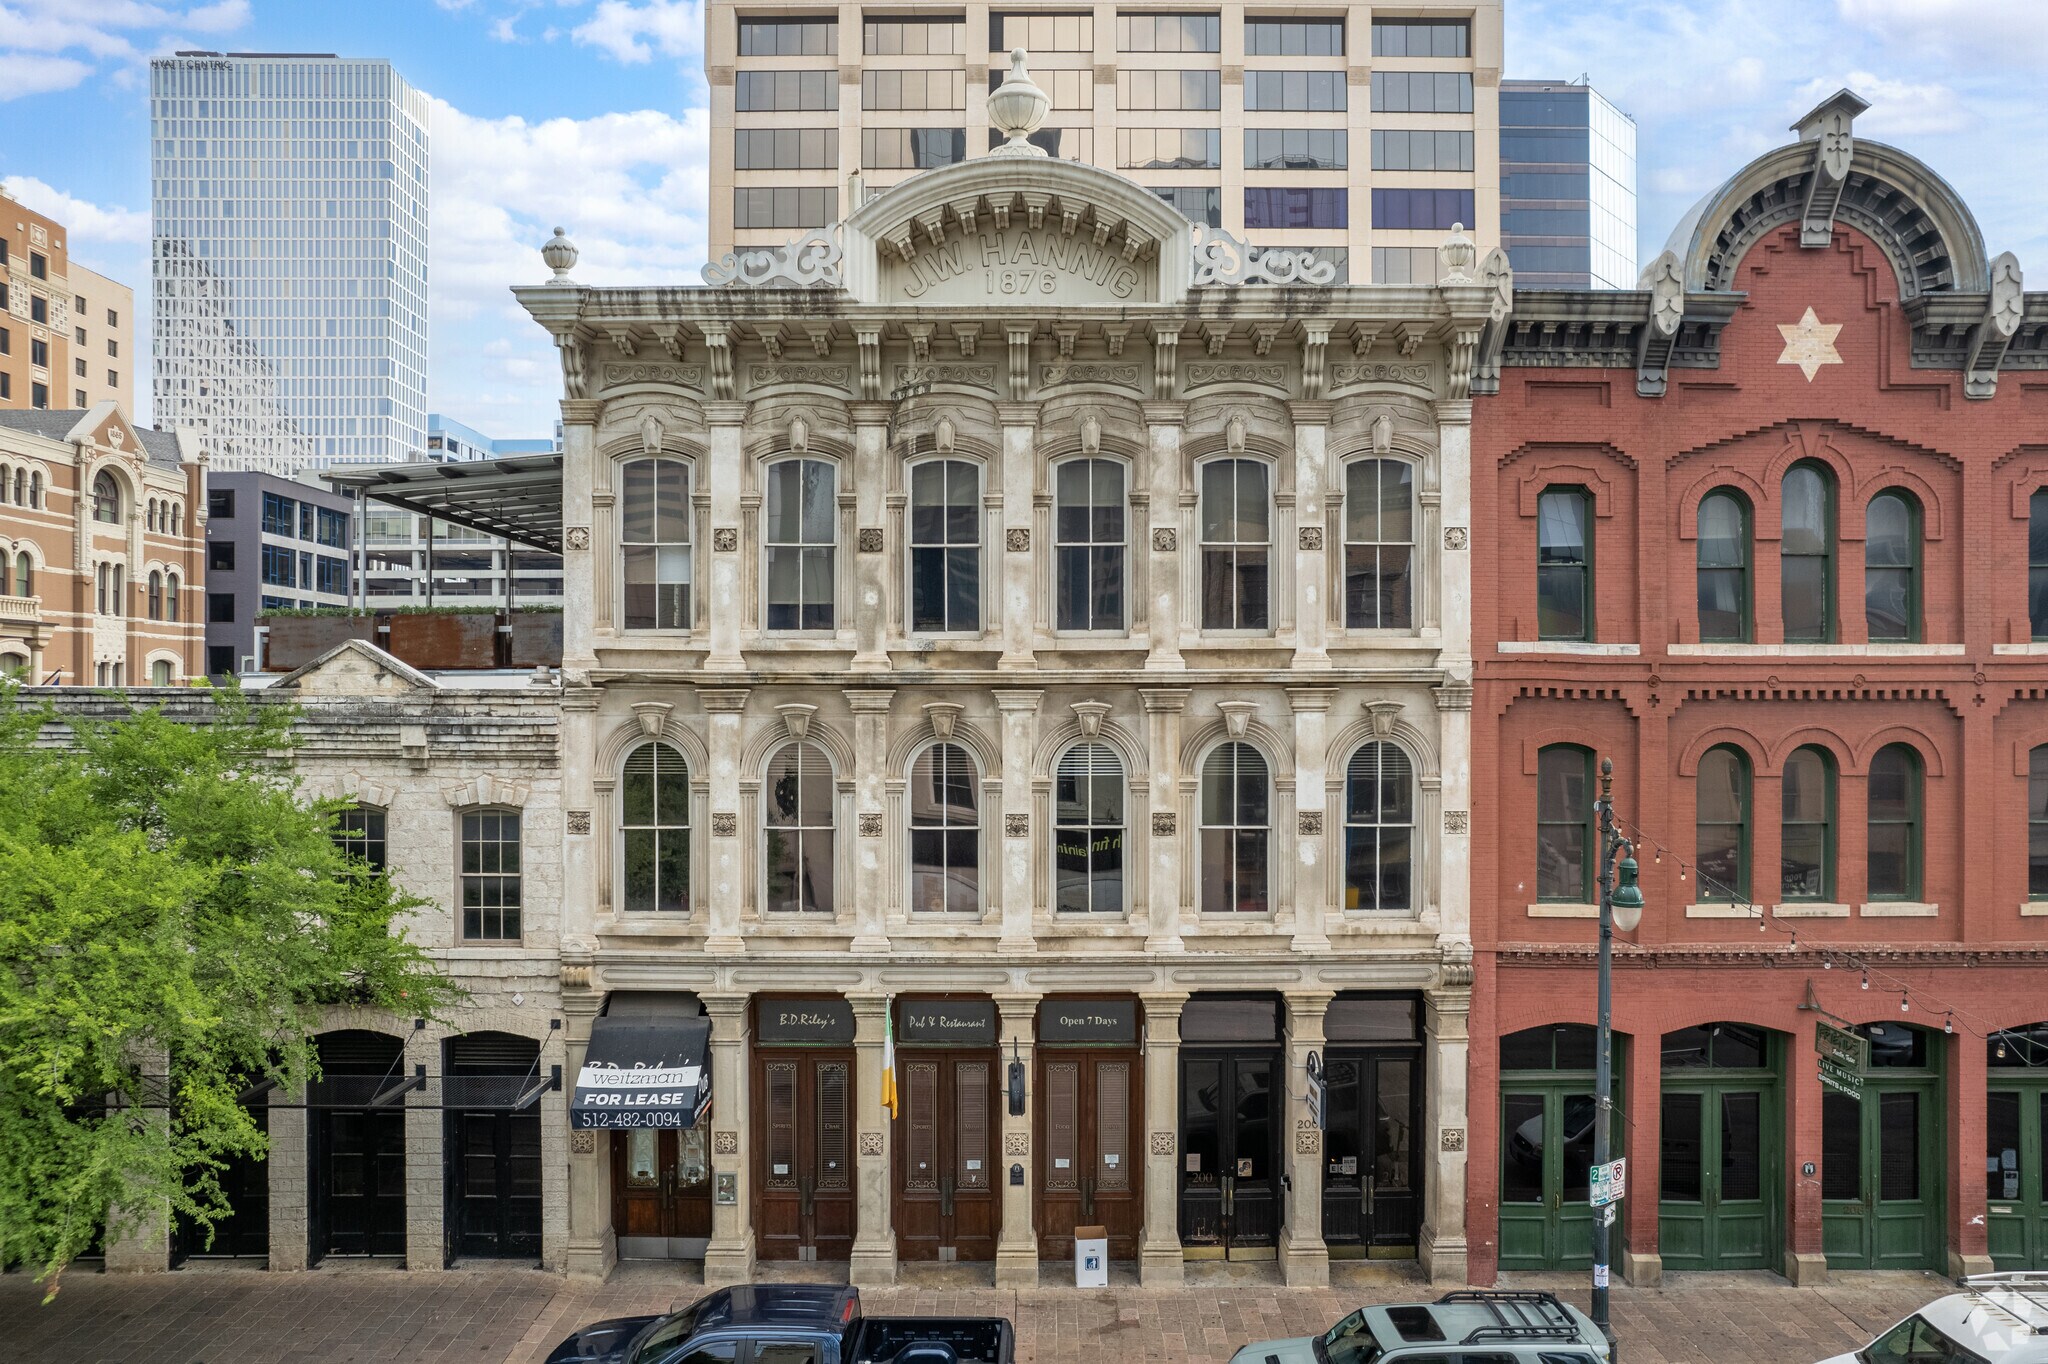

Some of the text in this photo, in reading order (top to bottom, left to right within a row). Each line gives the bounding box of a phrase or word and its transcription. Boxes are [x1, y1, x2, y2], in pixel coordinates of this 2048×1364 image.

[151, 60, 231, 69] HYATT CENTRIC
[904, 231, 1139, 298] J.W. HANNIG
[986, 270, 1056, 294] 1876
[909, 1015, 986, 1028] Pub & Restaurant
[1060, 1016, 1118, 1027] Open 7 Days
[593, 1071, 683, 1085] weitzman
[1818, 1060, 1860, 1086] LIVE MUSIC
[584, 1093, 622, 1105] FOR
[624, 1093, 684, 1105] LEASE
[1843, 1086, 1861, 1100] FOOD
[582, 1112, 681, 1127] 512-482-0094
[1192, 1172, 1213, 1183] 200
[1592, 1169, 1598, 1180] 2
